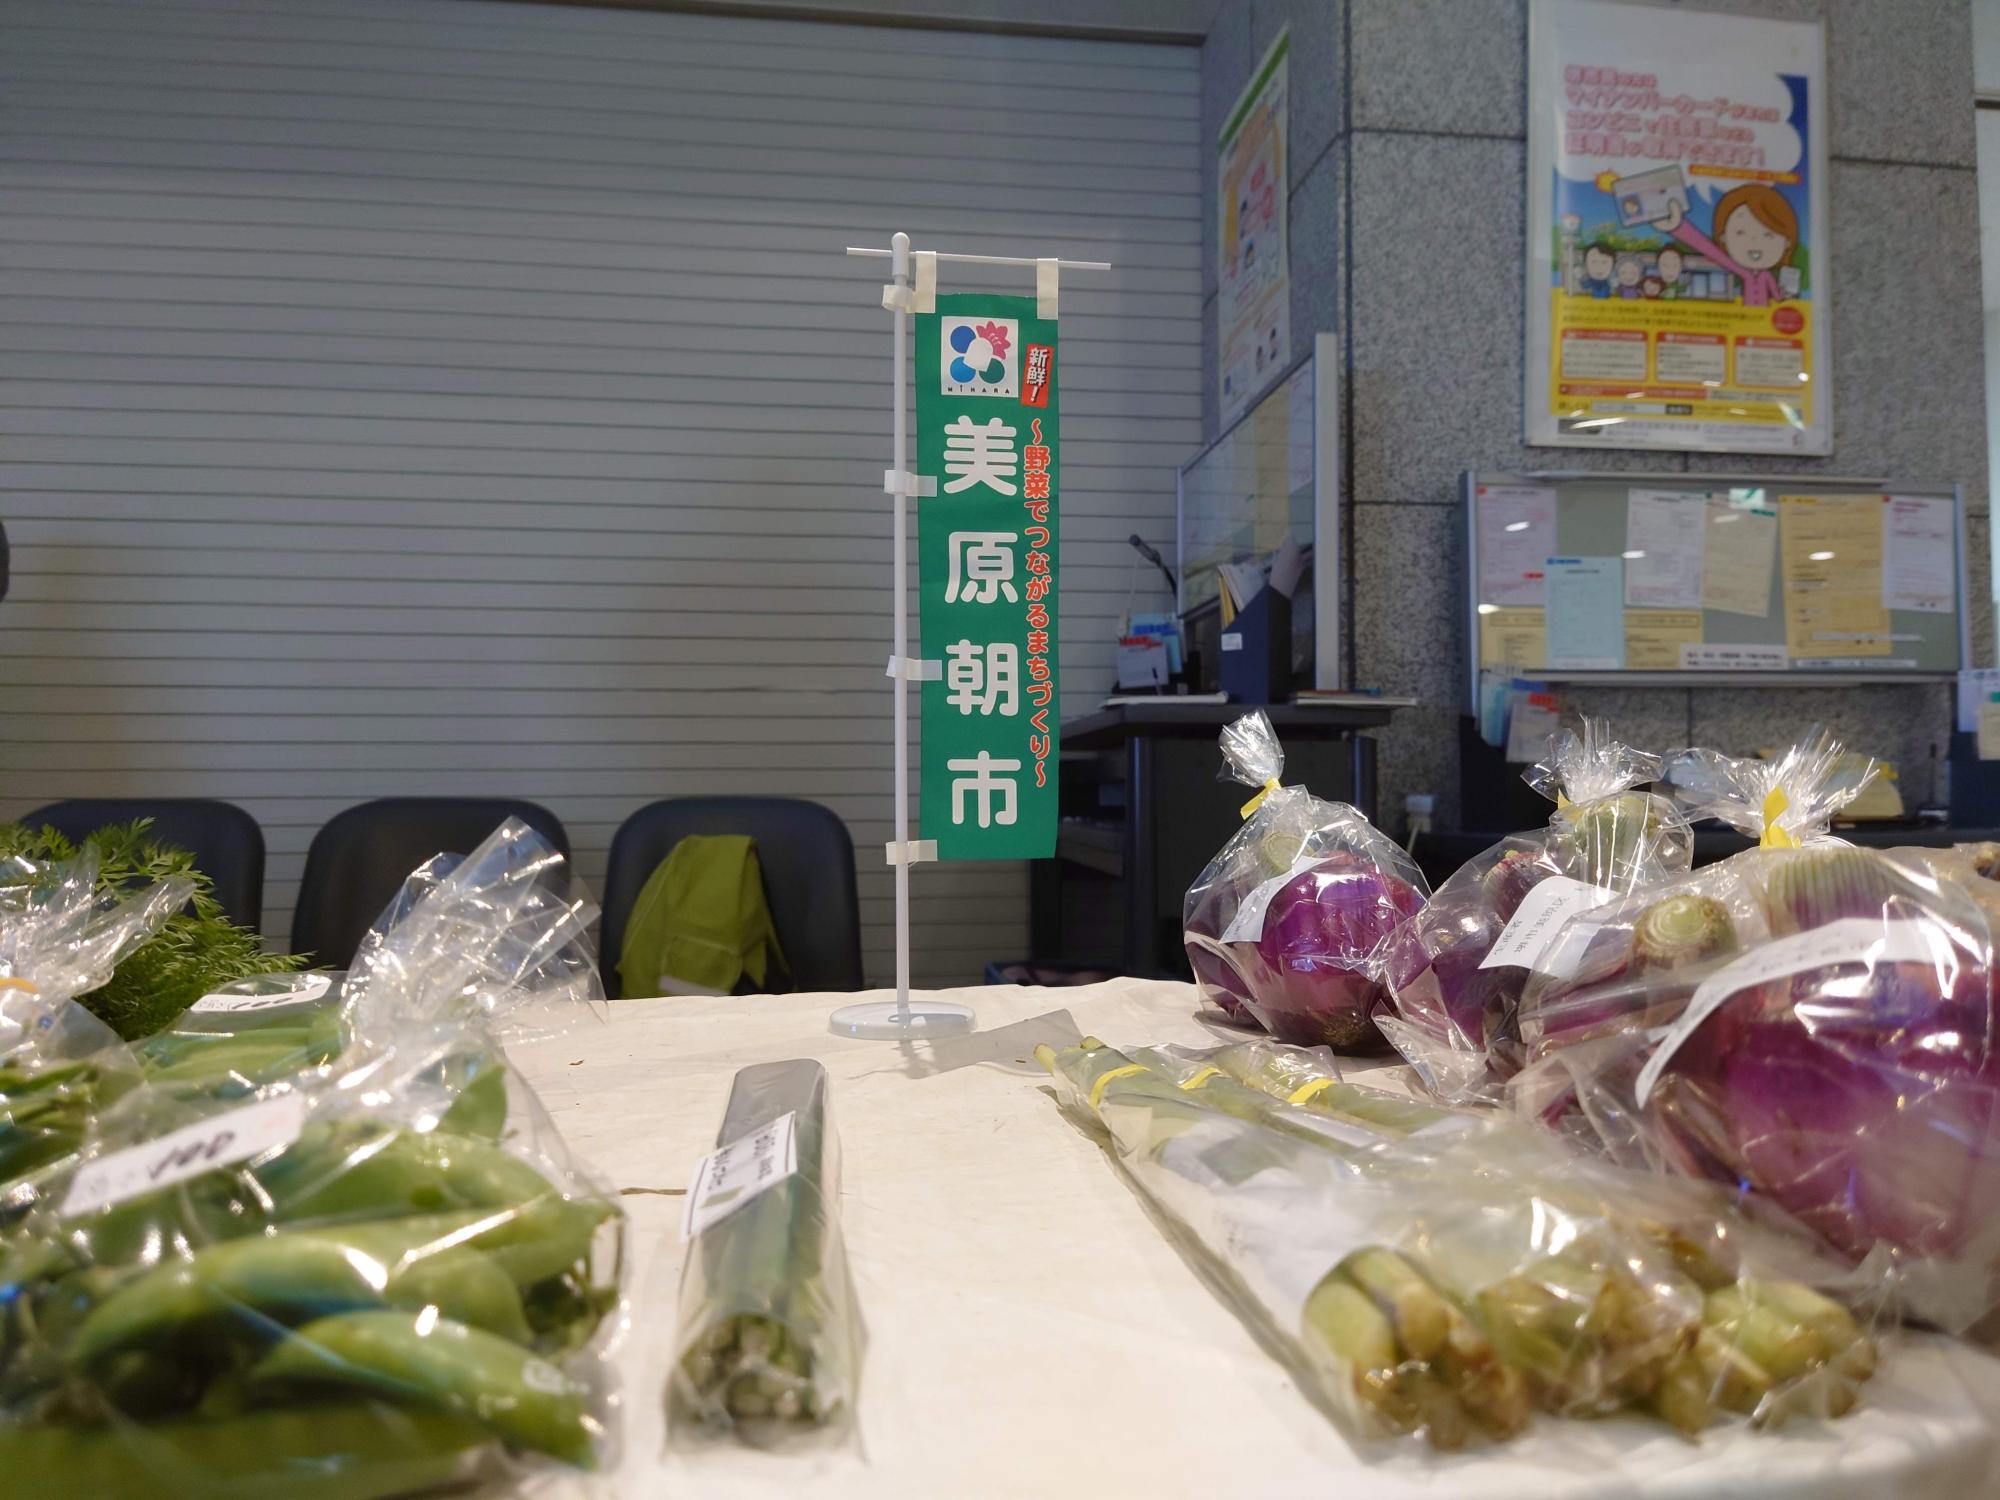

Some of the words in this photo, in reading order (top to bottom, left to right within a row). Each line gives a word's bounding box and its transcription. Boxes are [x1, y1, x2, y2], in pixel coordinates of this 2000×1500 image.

[1026, 347, 1048, 402] 新鮮！
[943, 415, 1022, 829] 美原朝市
[1024, 418, 1053, 788] ～野菜でつながるまちづくり～
